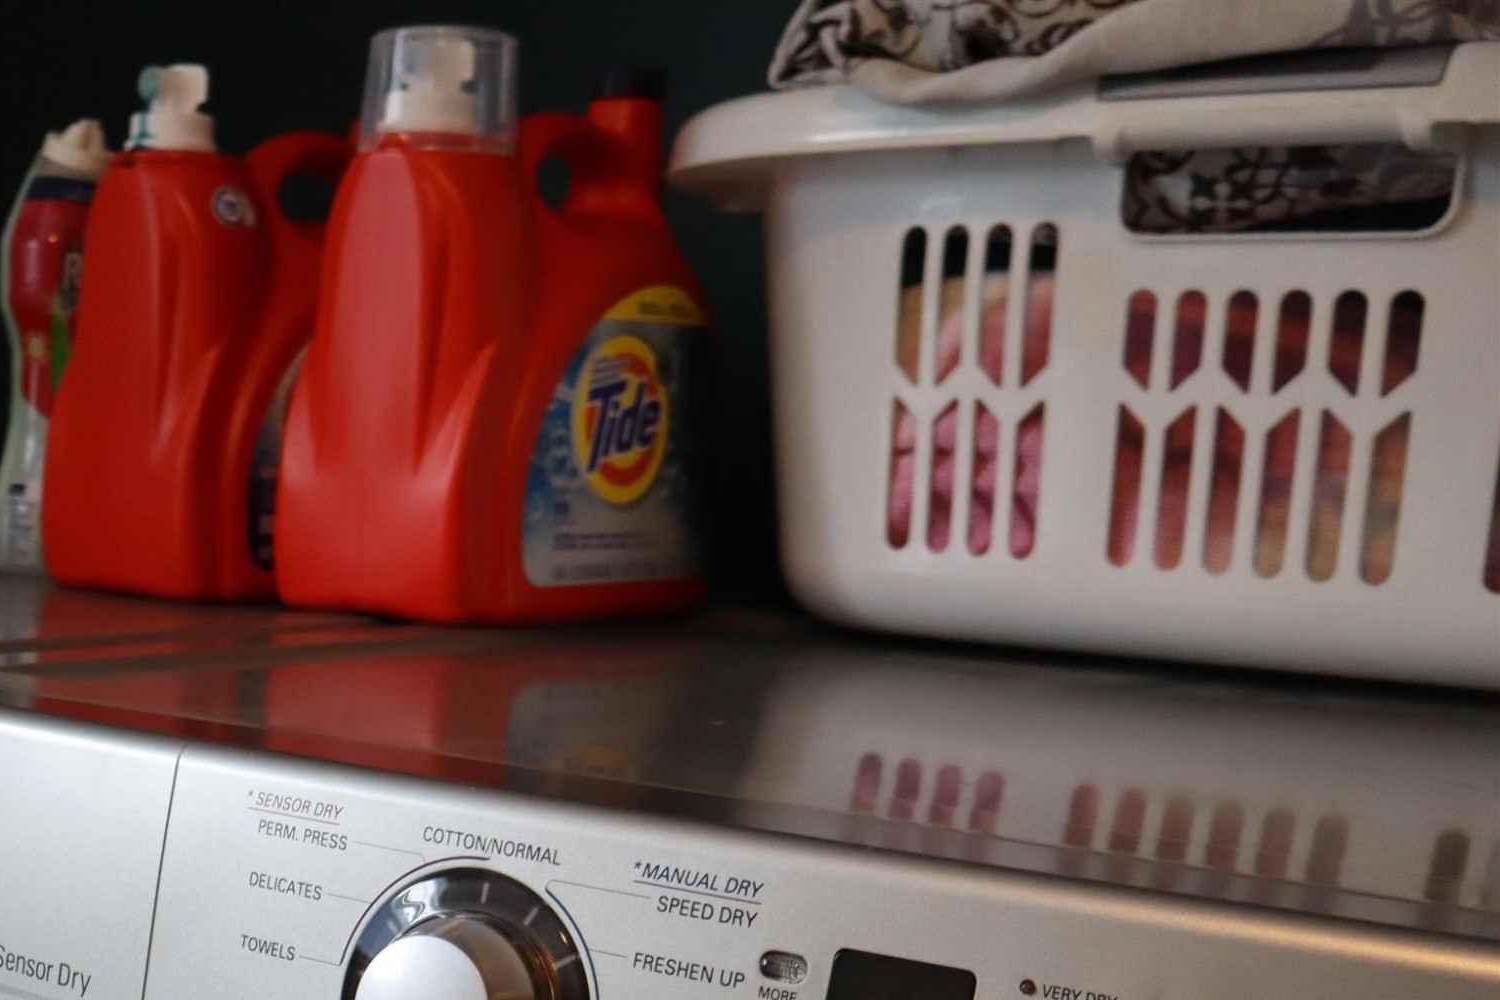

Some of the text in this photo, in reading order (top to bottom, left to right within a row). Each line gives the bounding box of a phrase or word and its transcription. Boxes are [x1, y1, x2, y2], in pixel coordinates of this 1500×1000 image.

[586, 380, 661, 473] Tide
[256, 791, 344, 820] SENSOR DRY
[258, 819, 348, 850] PERM. PRESS
[423, 826, 561, 866] COTTON/NORMAL
[249, 871, 322, 900] DELICATES
[725, 877, 765, 898] DRY
[656, 895, 758, 928] SPEED DRY
[240, 934, 296, 961] TOWELS
[57, 962, 91, 998] Dry
[633, 952, 745, 989] FRESHEN UP
